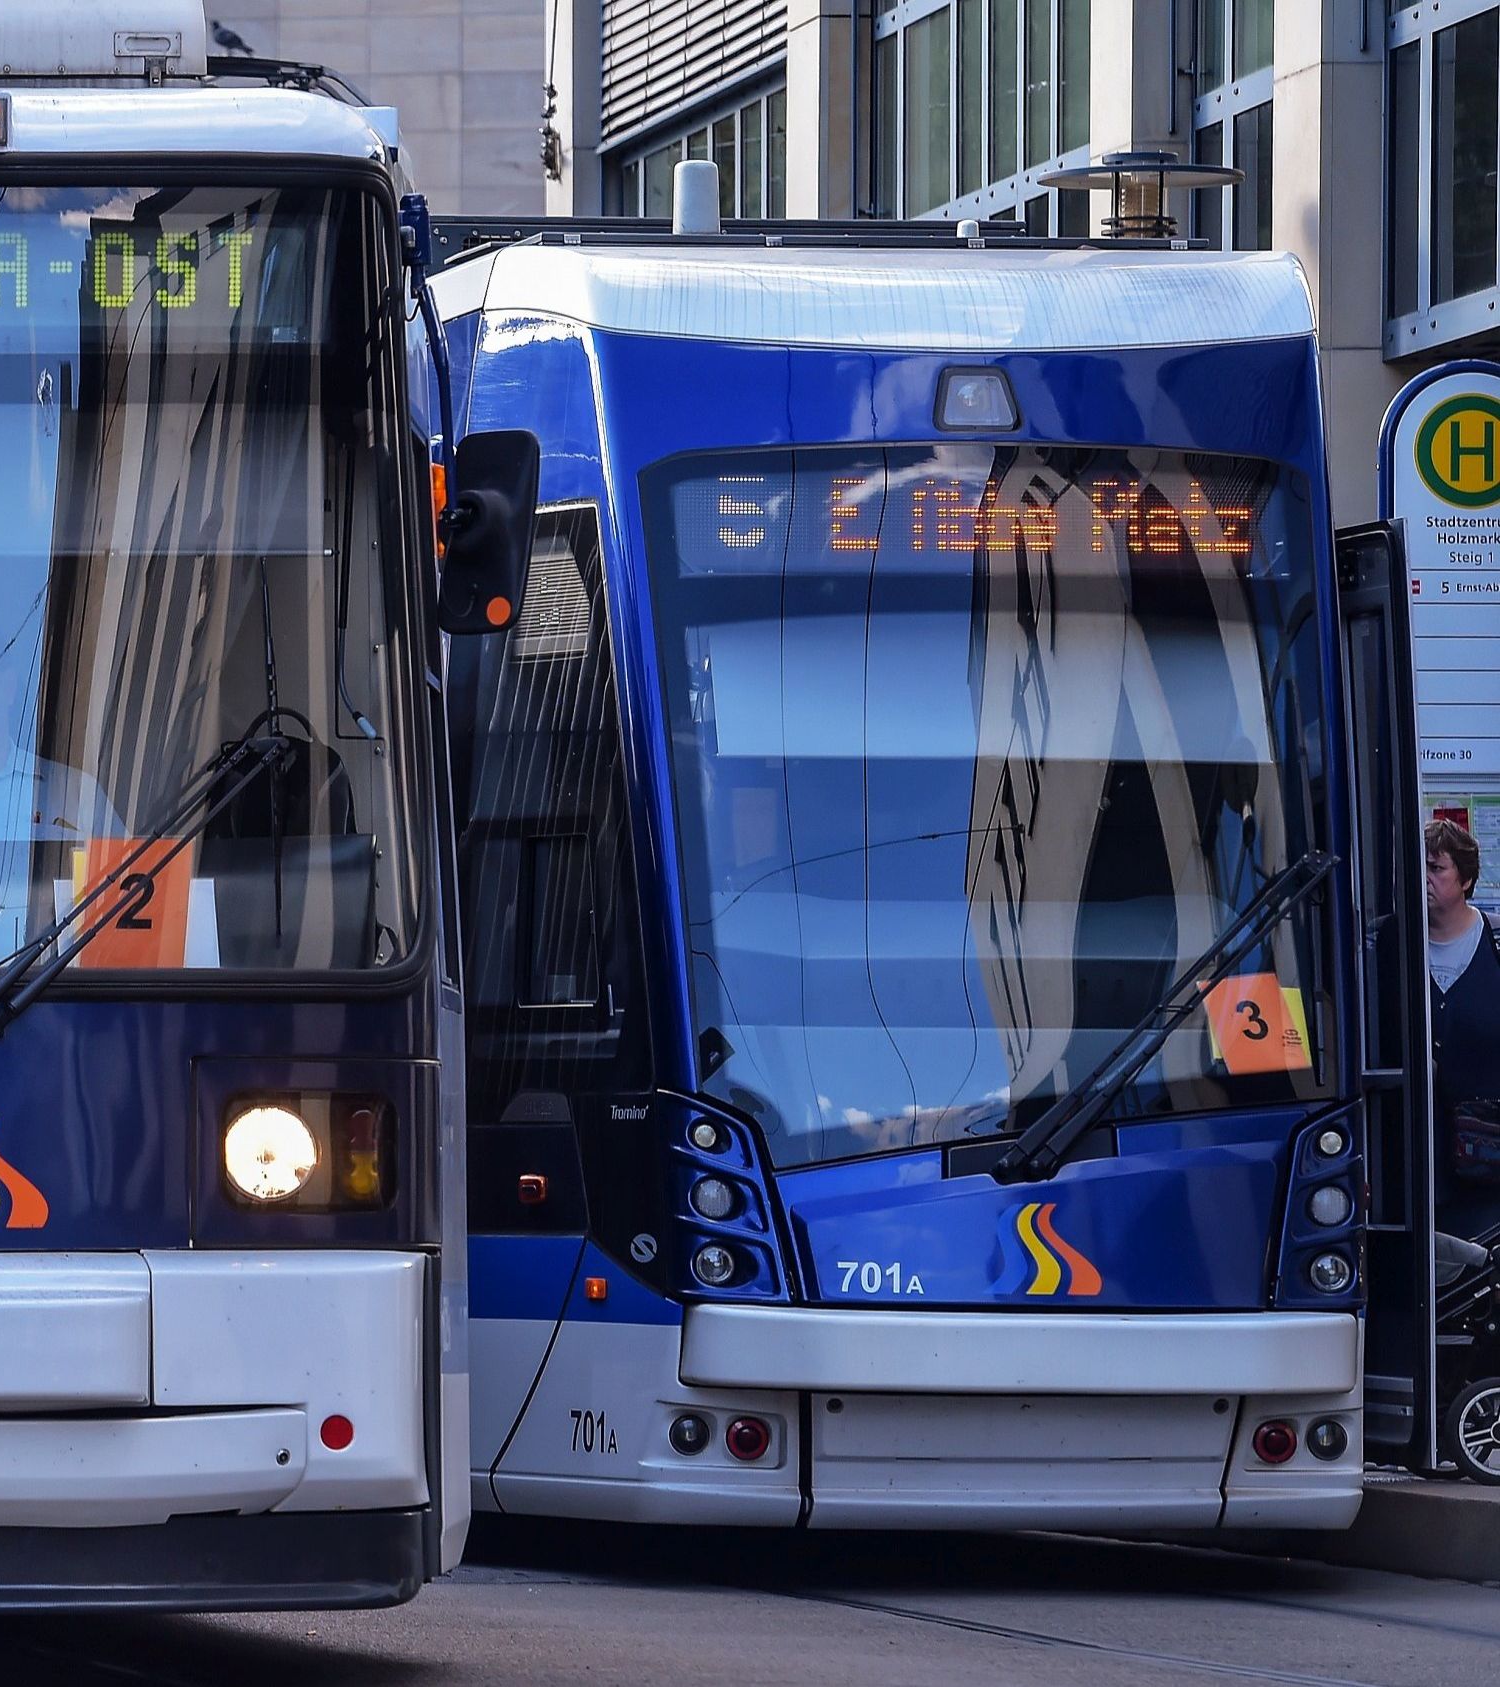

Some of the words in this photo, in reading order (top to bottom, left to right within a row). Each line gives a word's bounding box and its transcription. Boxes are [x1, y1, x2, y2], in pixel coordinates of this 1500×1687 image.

[1449, 551, 1483, 566] Steig
[1488, 551, 1494, 563] 1
[1441, 581, 1450, 594] 5
[1460, 750, 1472, 760] 30
[115, 873, 156, 930] 2
[1236, 1000, 1269, 1041] 3
